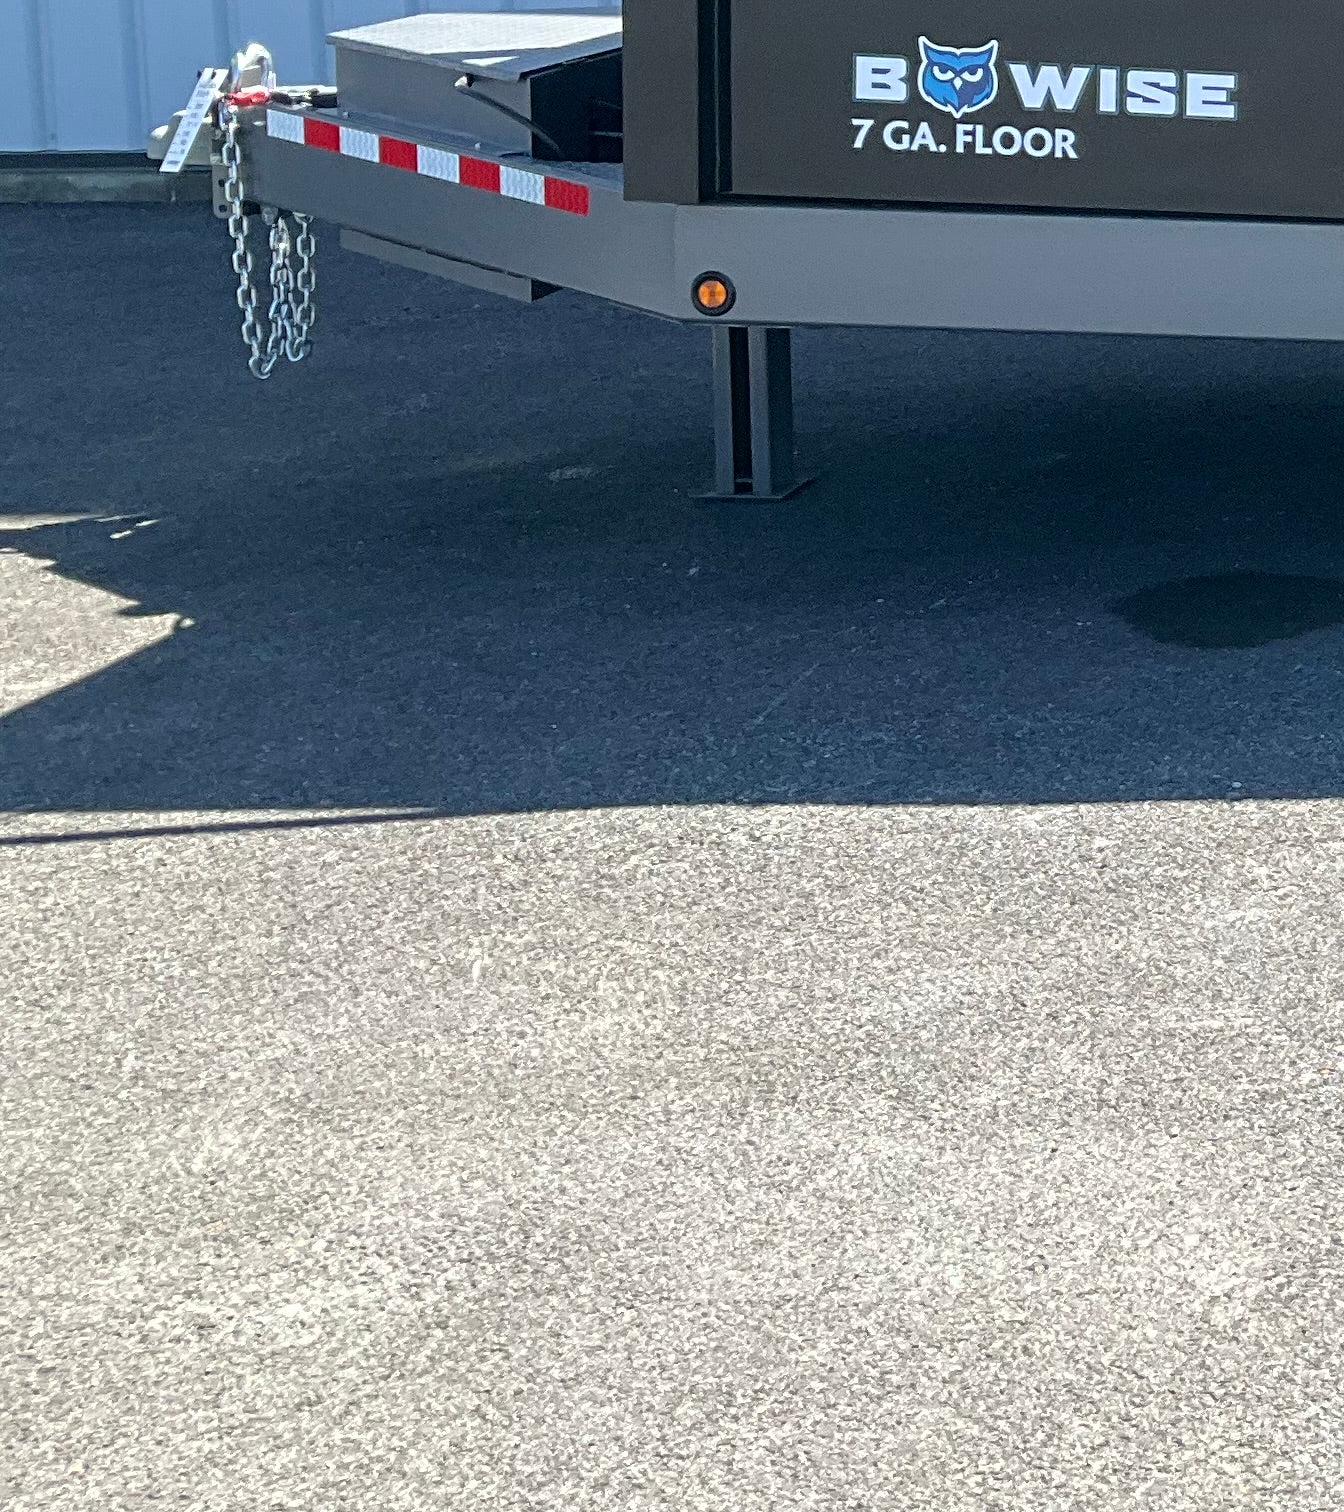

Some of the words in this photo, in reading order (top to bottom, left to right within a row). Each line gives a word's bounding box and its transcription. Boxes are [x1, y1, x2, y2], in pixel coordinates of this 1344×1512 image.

[851, 118, 875, 149] 7
[883, 120, 947, 153] GA.
[955, 123, 1079, 159] FLOOR
